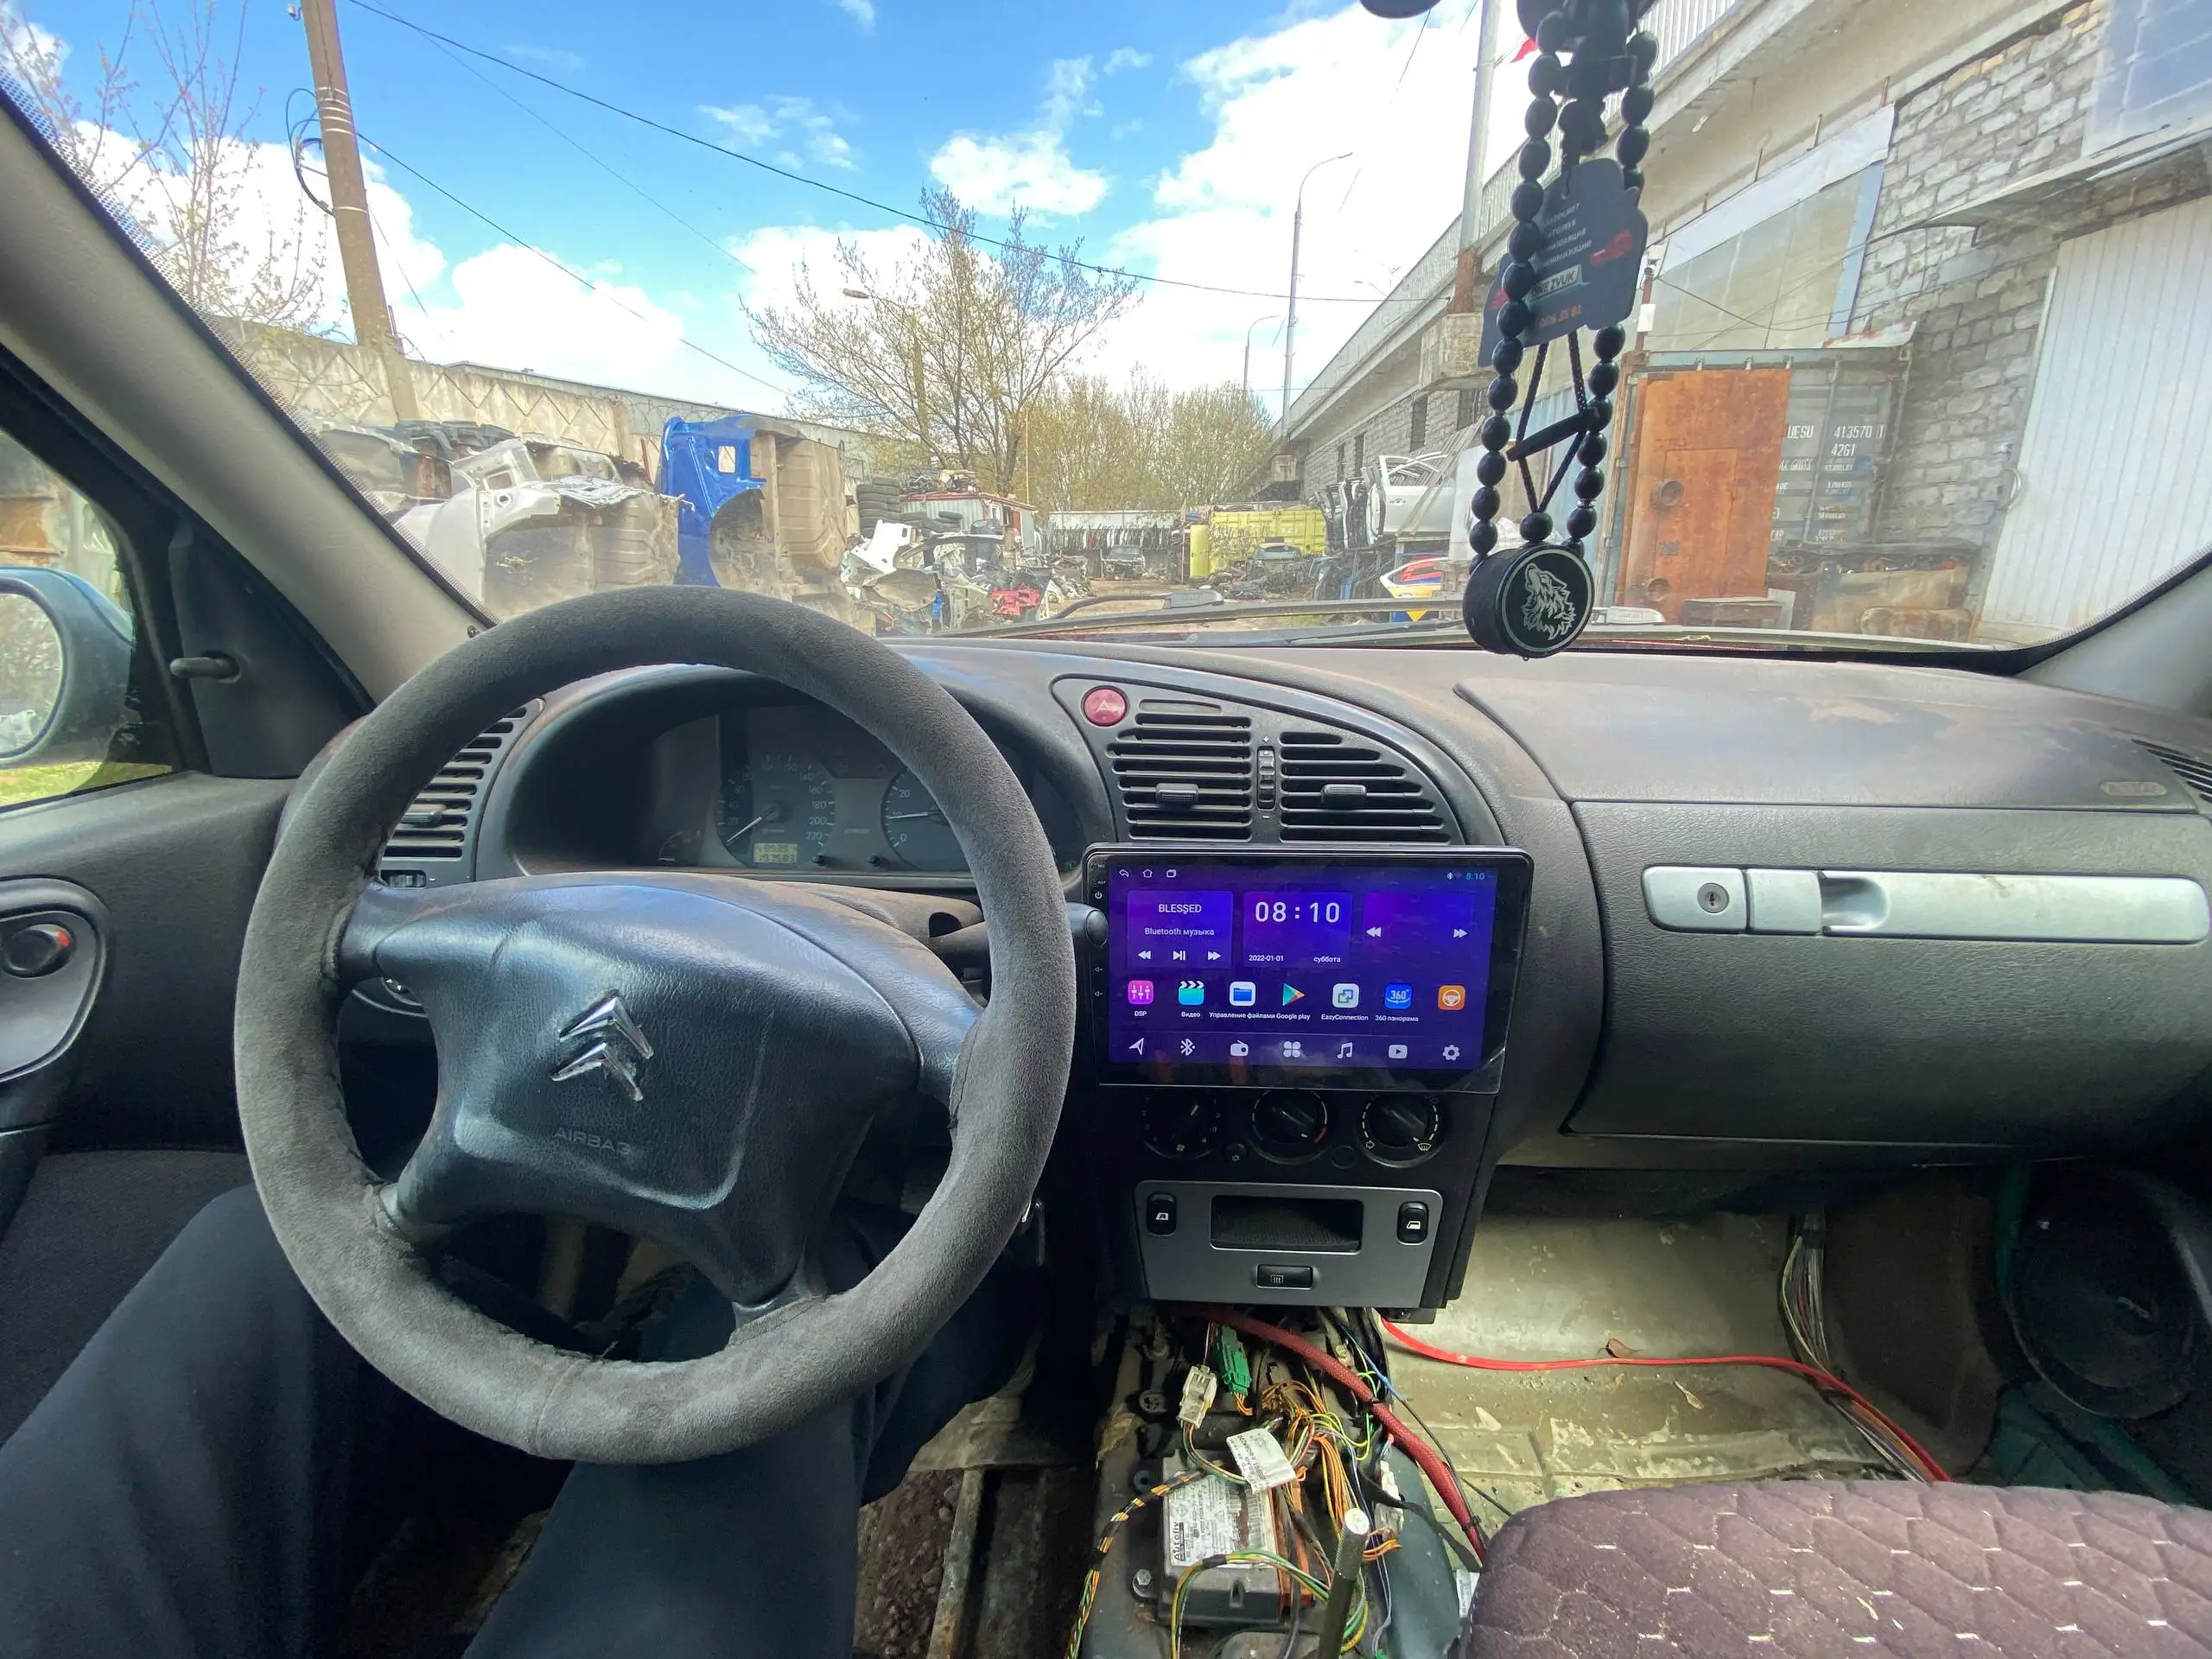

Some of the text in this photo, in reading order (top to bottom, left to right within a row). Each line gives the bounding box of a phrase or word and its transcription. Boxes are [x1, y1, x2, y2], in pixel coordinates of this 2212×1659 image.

[1788, 425, 1815, 439] UESU
[1834, 425, 1873, 439] 413570
[1144, 927, 1215, 938] Bluetooth музыка
[1313, 955, 1341, 963] суббота
[1171, 1521, 1180, 1562] Autoliv
